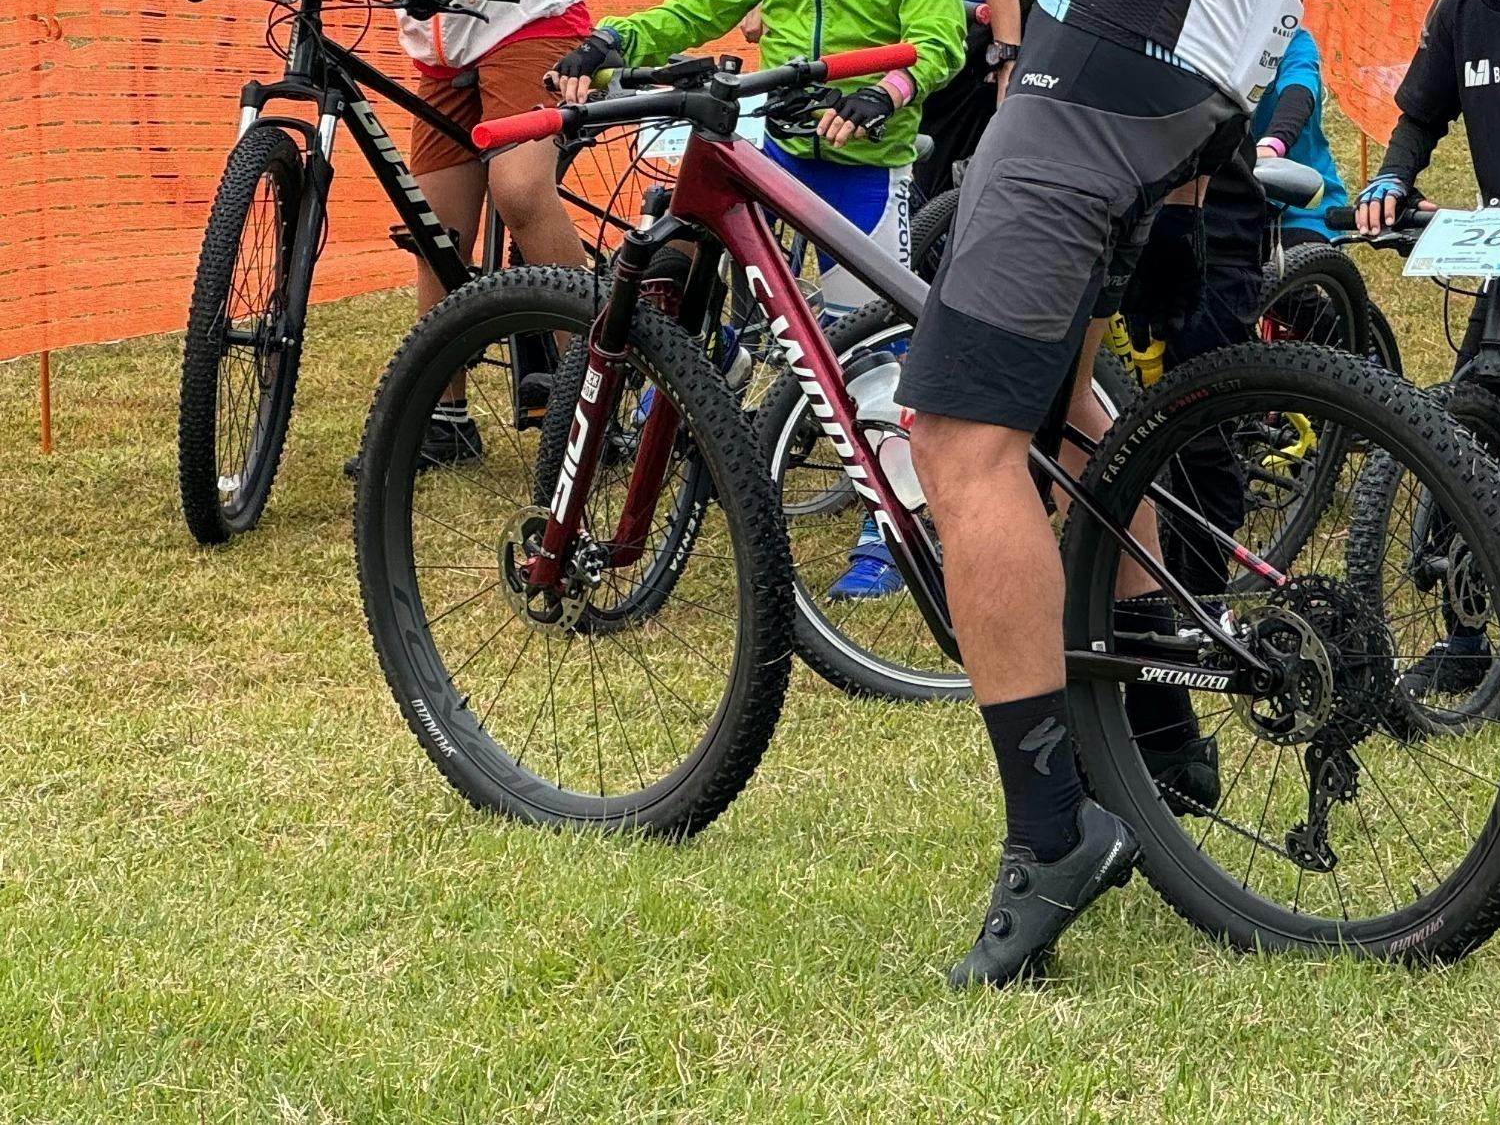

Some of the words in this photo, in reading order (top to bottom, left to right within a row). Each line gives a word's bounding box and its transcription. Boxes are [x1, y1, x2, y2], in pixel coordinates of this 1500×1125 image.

[1021, 73, 1060, 89] OAKLEY
[1102, 442, 1133, 484] FAST
[1128, 410, 1169, 445] TRAK
[669, 502, 702, 572] KENDA
[1137, 665, 1229, 691] SPECIALIZED
[410, 698, 458, 759] SPECIALIZED
[1095, 839, 1123, 883] S-WORKS
